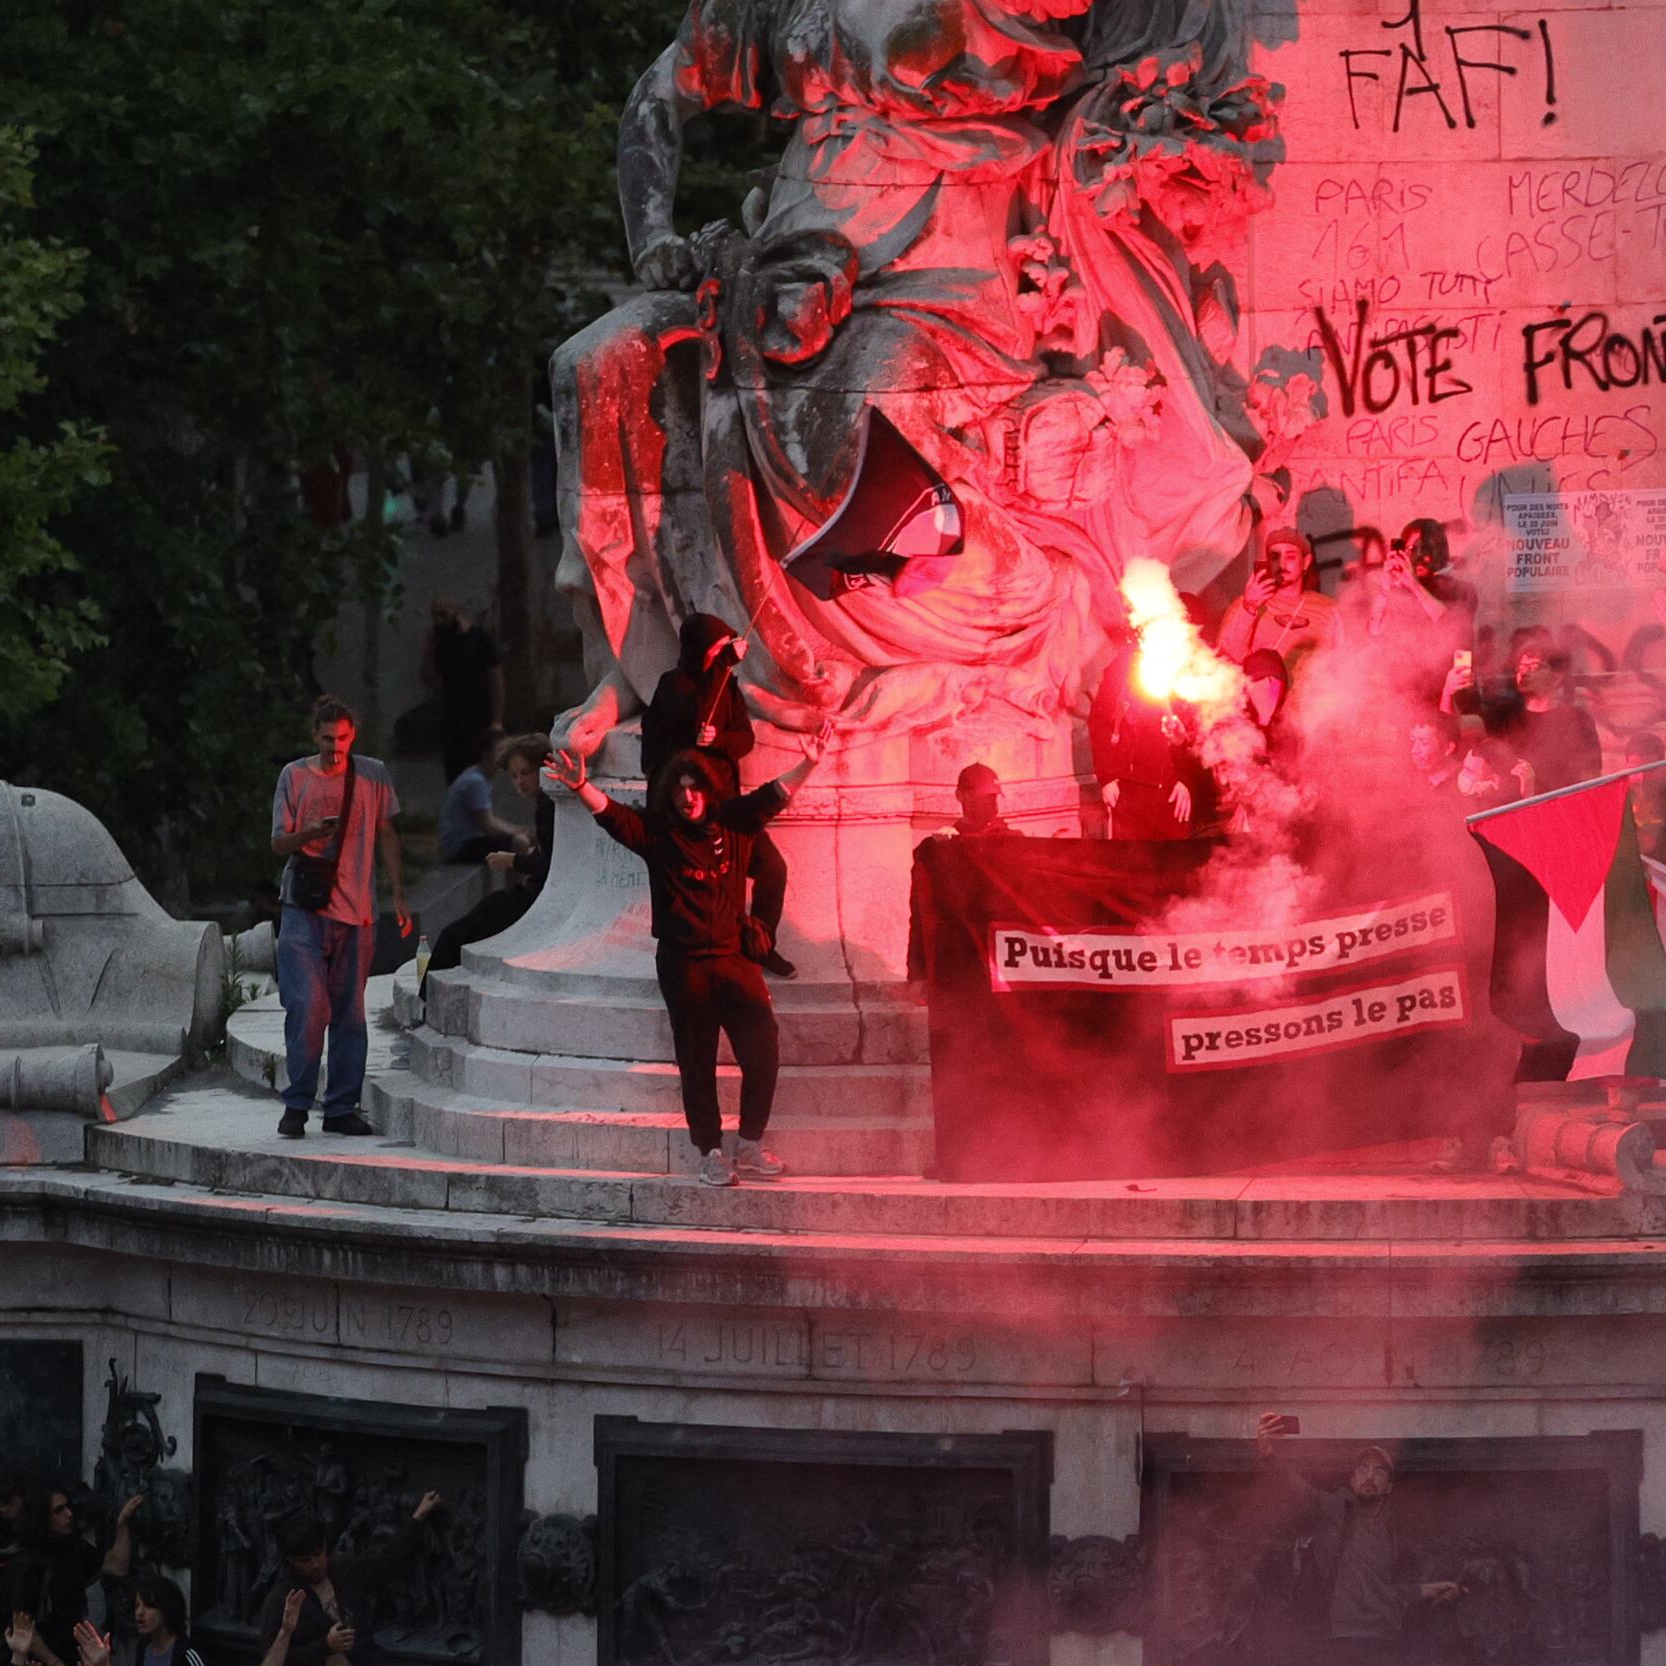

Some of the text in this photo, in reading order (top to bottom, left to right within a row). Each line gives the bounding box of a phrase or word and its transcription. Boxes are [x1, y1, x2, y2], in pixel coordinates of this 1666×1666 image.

[1314, 298, 1473, 417] VOTE
[1456, 405, 1657, 473] GAUCHES
[1516, 552, 1561, 565] FRONT
[1004, 936, 1158, 979] Puisque
[1168, 942, 1202, 971] le
[1336, 904, 1448, 960] presse
[1181, 981, 1458, 1061] pressons le pas
